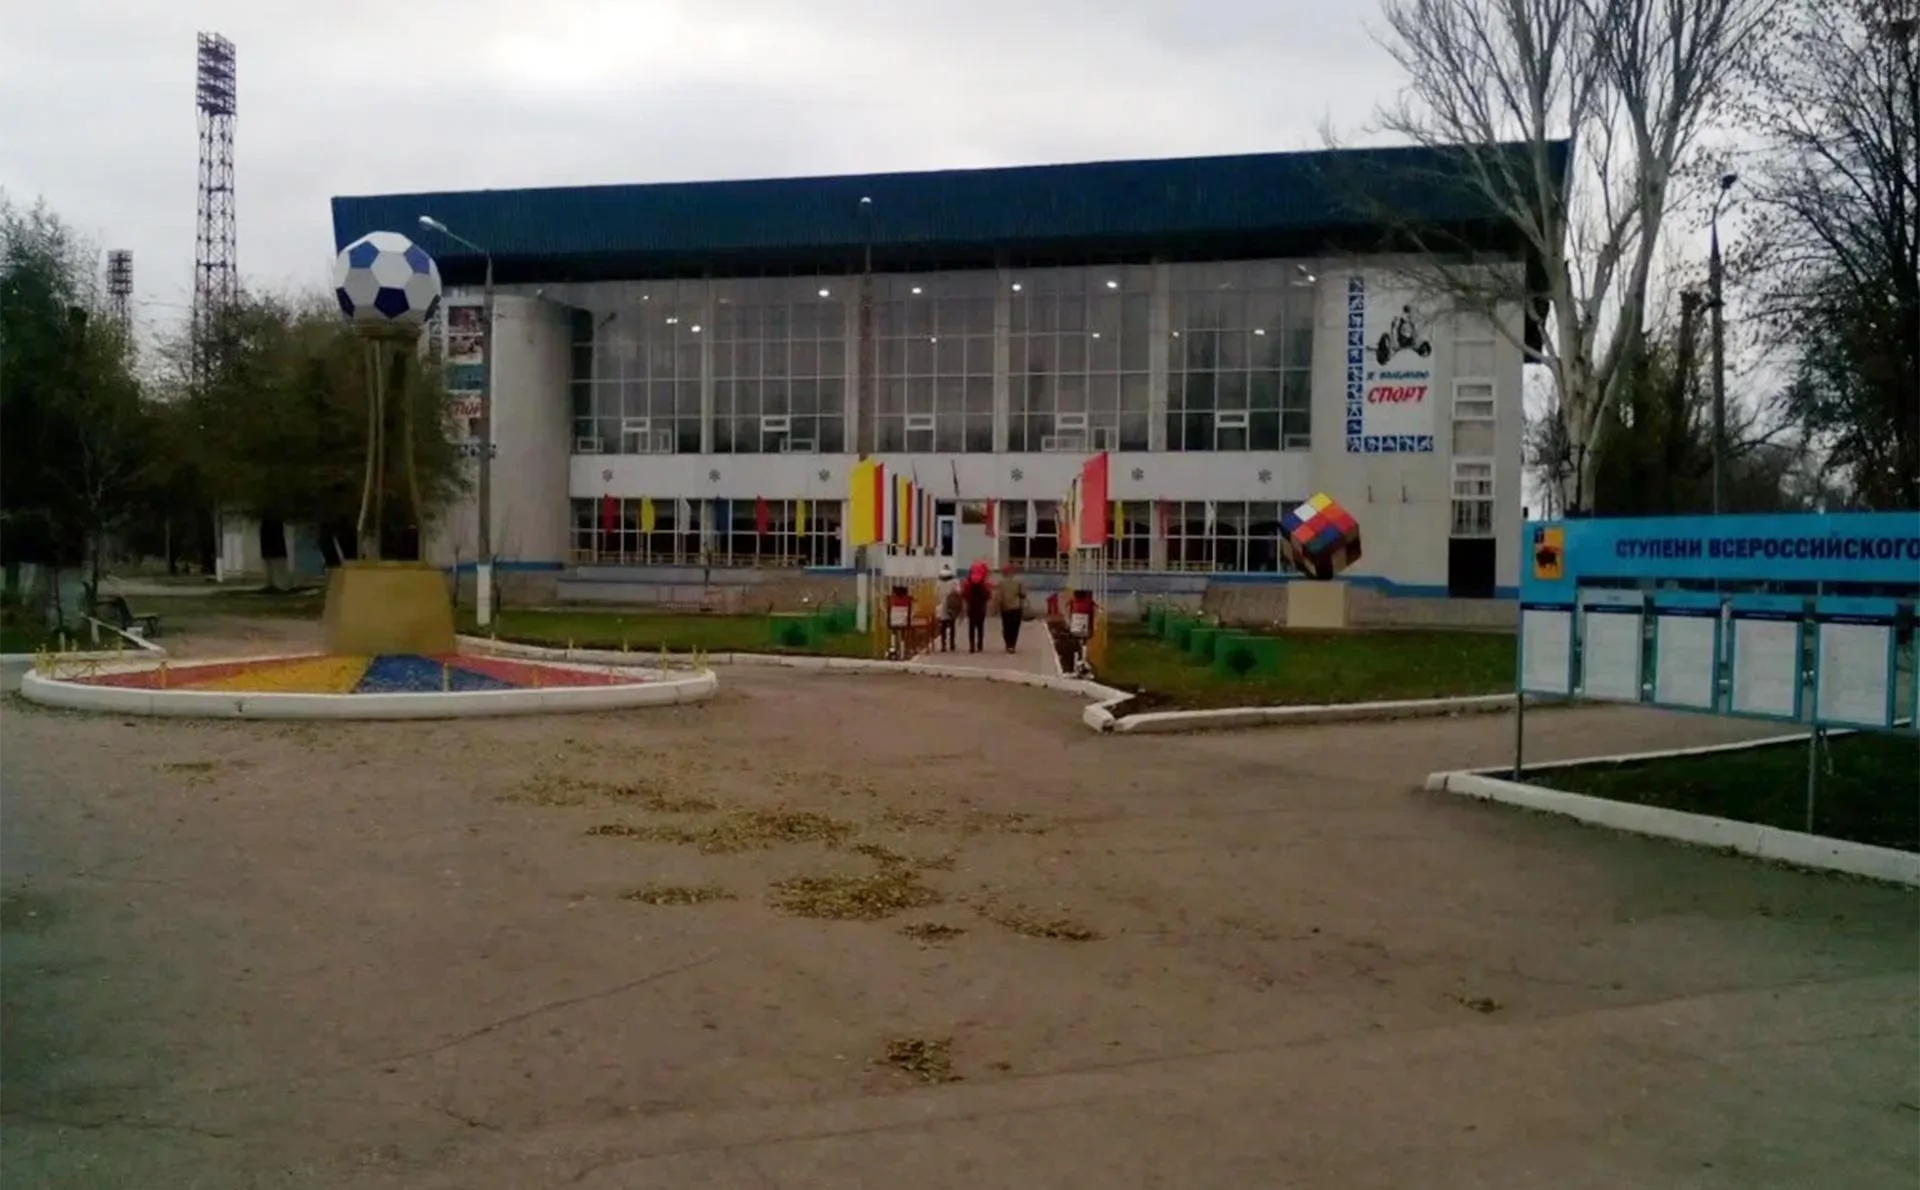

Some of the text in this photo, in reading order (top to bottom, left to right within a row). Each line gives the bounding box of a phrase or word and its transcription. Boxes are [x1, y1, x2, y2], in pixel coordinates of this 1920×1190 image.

[1368, 385, 1427, 403] СПОРТ
[1616, 535, 1920, 560] СТУПЕНИ ВСЕРОССИЙСКОГО
